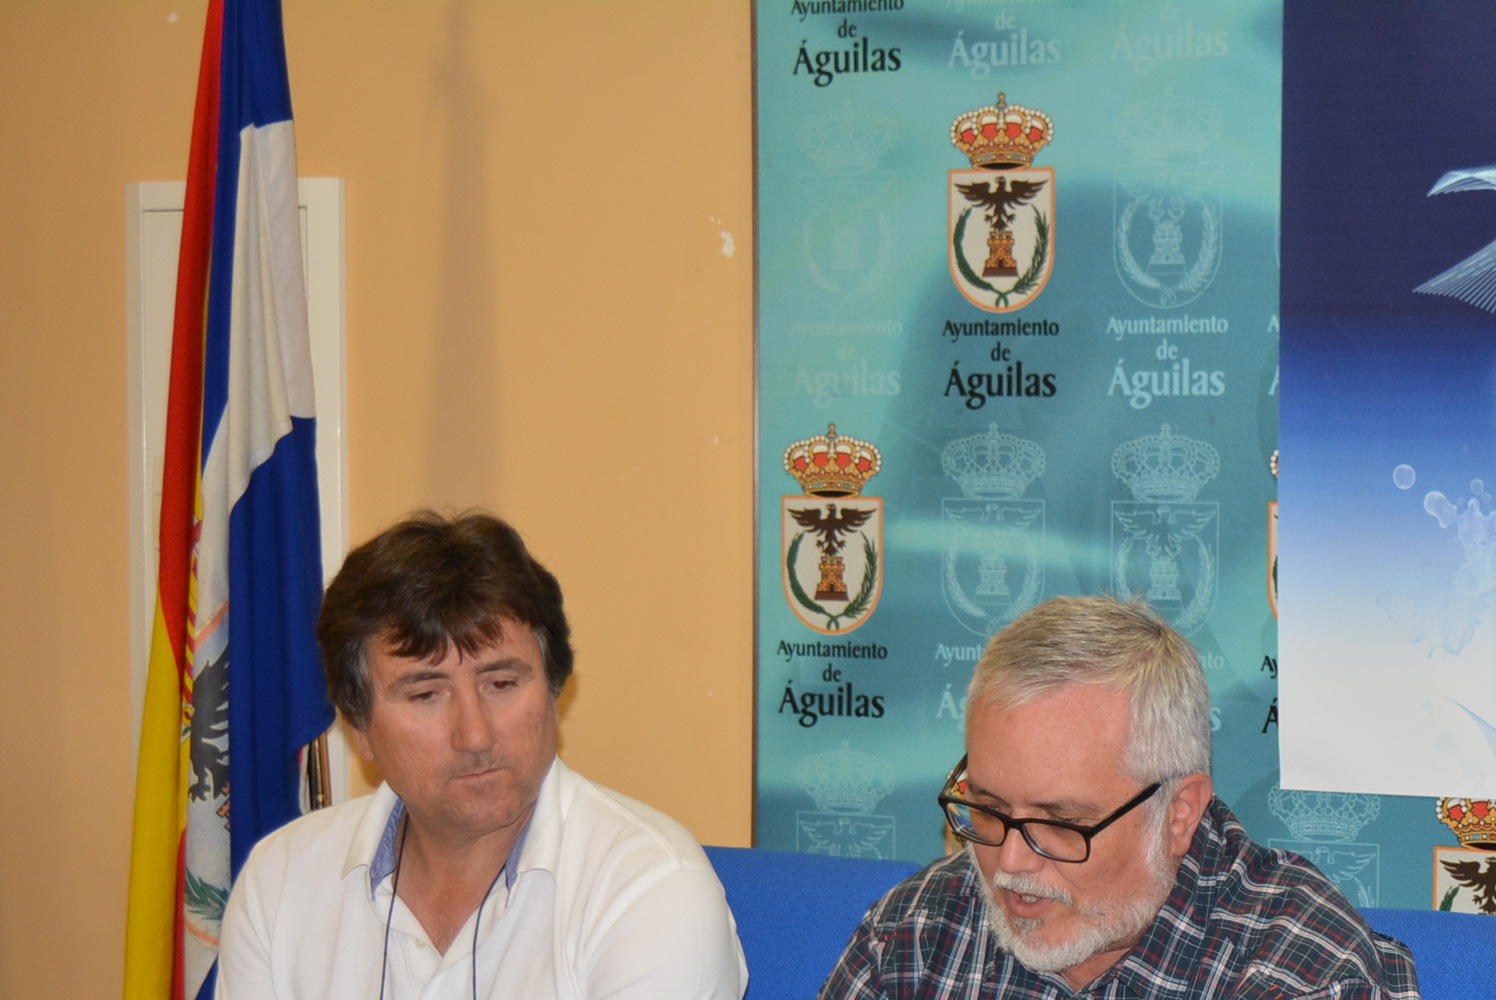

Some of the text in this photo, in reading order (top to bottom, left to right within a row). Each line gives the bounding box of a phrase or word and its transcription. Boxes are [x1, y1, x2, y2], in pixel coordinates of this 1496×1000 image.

[837, 18, 858, 39] de
[793, 36, 902, 88] Águilas
[947, 28, 1062, 79] Águilas
[942, 318, 1060, 343] Ayuntamiento
[1105, 314, 1230, 342] Ayuntamiento
[990, 340, 1012, 362] de
[1156, 338, 1179, 361] de
[943, 360, 1058, 411] Águilas
[1106, 358, 1227, 410] Águilas
[776, 639, 889, 663] Ayuntamiento
[822, 662, 843, 683] de
[778, 679, 886, 728] Águilas
